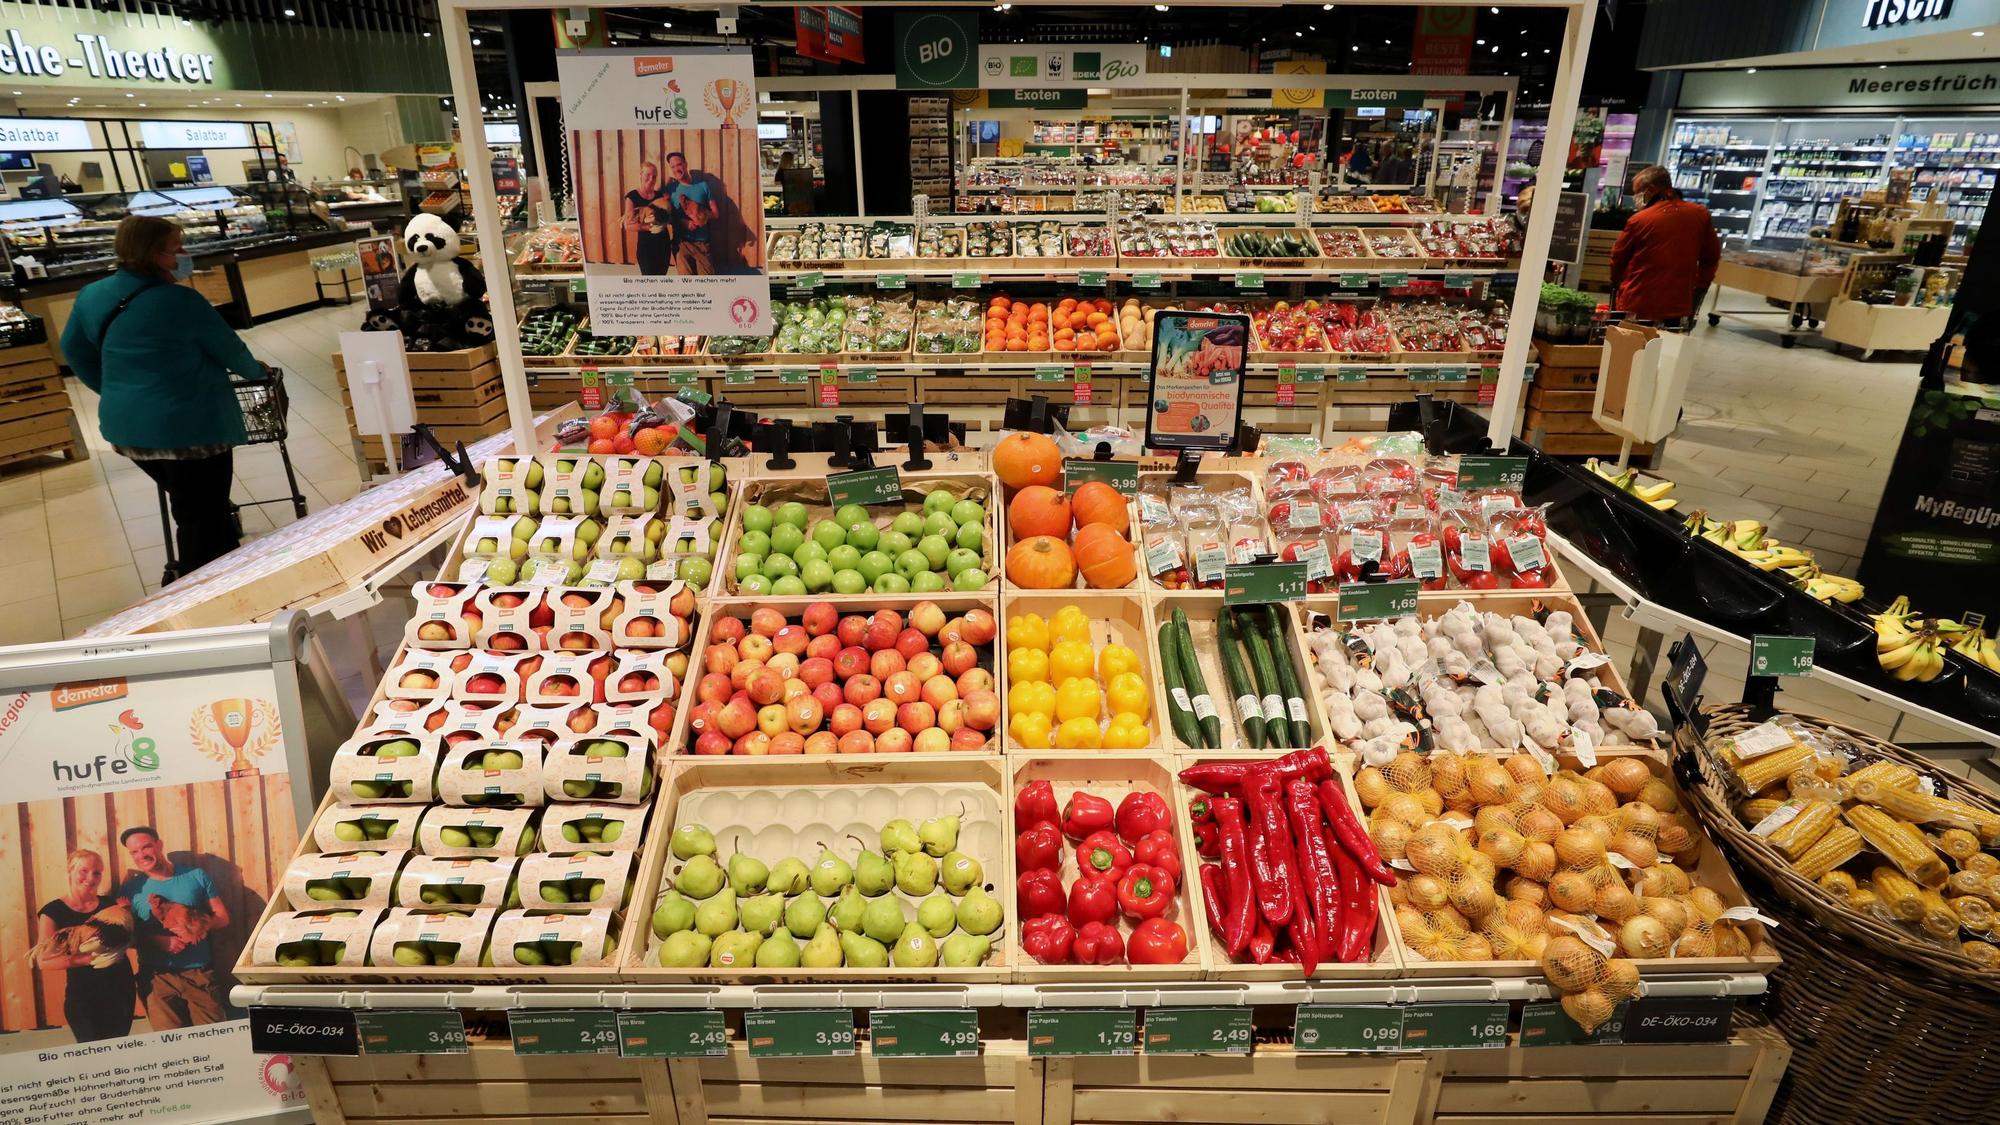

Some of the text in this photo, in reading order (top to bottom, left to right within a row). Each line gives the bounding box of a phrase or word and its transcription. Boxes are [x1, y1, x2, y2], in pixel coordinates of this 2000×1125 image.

[912, 37, 953, 64] BIO
[638, 62, 670, 73] demeter
[1103, 60, 1139, 80] Bio
[1014, 89, 1060, 100] Exoten
[1351, 88, 1397, 100] Exoten
[0, 127, 60, 142] Salatbar
[186, 129, 228, 142] Salatbar
[1167, 391, 1230, 401] biodynamische
[1201, 401, 1234, 411] Qualität
[1111, 478, 1137, 489] 3,99
[1500, 473, 1524, 482] 2,99
[875, 483, 899, 494] 4,99
[360, 530, 388, 554] Wir
[1278, 582, 1305, 594] 1,11
[1390, 599, 1416, 610] 1,69
[1792, 656, 1813, 668] 1,69
[57, 683, 119, 704] demeter
[1641, 1016, 1718, 1027] DE-ÖKO-034
[266, 1023, 344, 1037] DE-ÖKO-034
[1212, 1030, 1249, 1044] 2,49
[1363, 1028, 1399, 1041] 0,99
[1470, 1025, 1505, 1039] 1,69
[429, 1031, 464, 1044] 3,49
[580, 1031, 616, 1044] 2,49
[689, 1032, 726, 1046] 2,49
[816, 1032, 853, 1046] 3,99
[940, 1032, 977, 1046] 4,99
[1098, 1031, 1133, 1046] 1,79
[38, 1052, 59, 1063] Bio
[63, 1044, 112, 1058] machen
[161, 1033, 183, 1044] Wir
[188, 1027, 234, 1040] machen
[1, 1054, 211, 1093] ist nicht gleich Ei und Bio nicht gleich Bio!
[74, 1076, 145, 1093] Hühnerhaltung
[149, 1073, 160, 1081] im
[164, 1067, 200, 1079] mobilen
[204, 1063, 225, 1073] Stall
[29, 1099, 76, 1112] Aufzucht
[80, 1094, 96, 1103] der
[100, 1084, 162, 1100] Bruderhähne
[165, 1080, 184, 1090] und
[187, 1075, 224, 1086] Hennen
[78, 1106, 102, 1115] ohne
[106, 1096, 161, 1111] Gentechnik
[99, 1113, 124, 1124] mehr
[128, 1110, 144, 1119] auf
